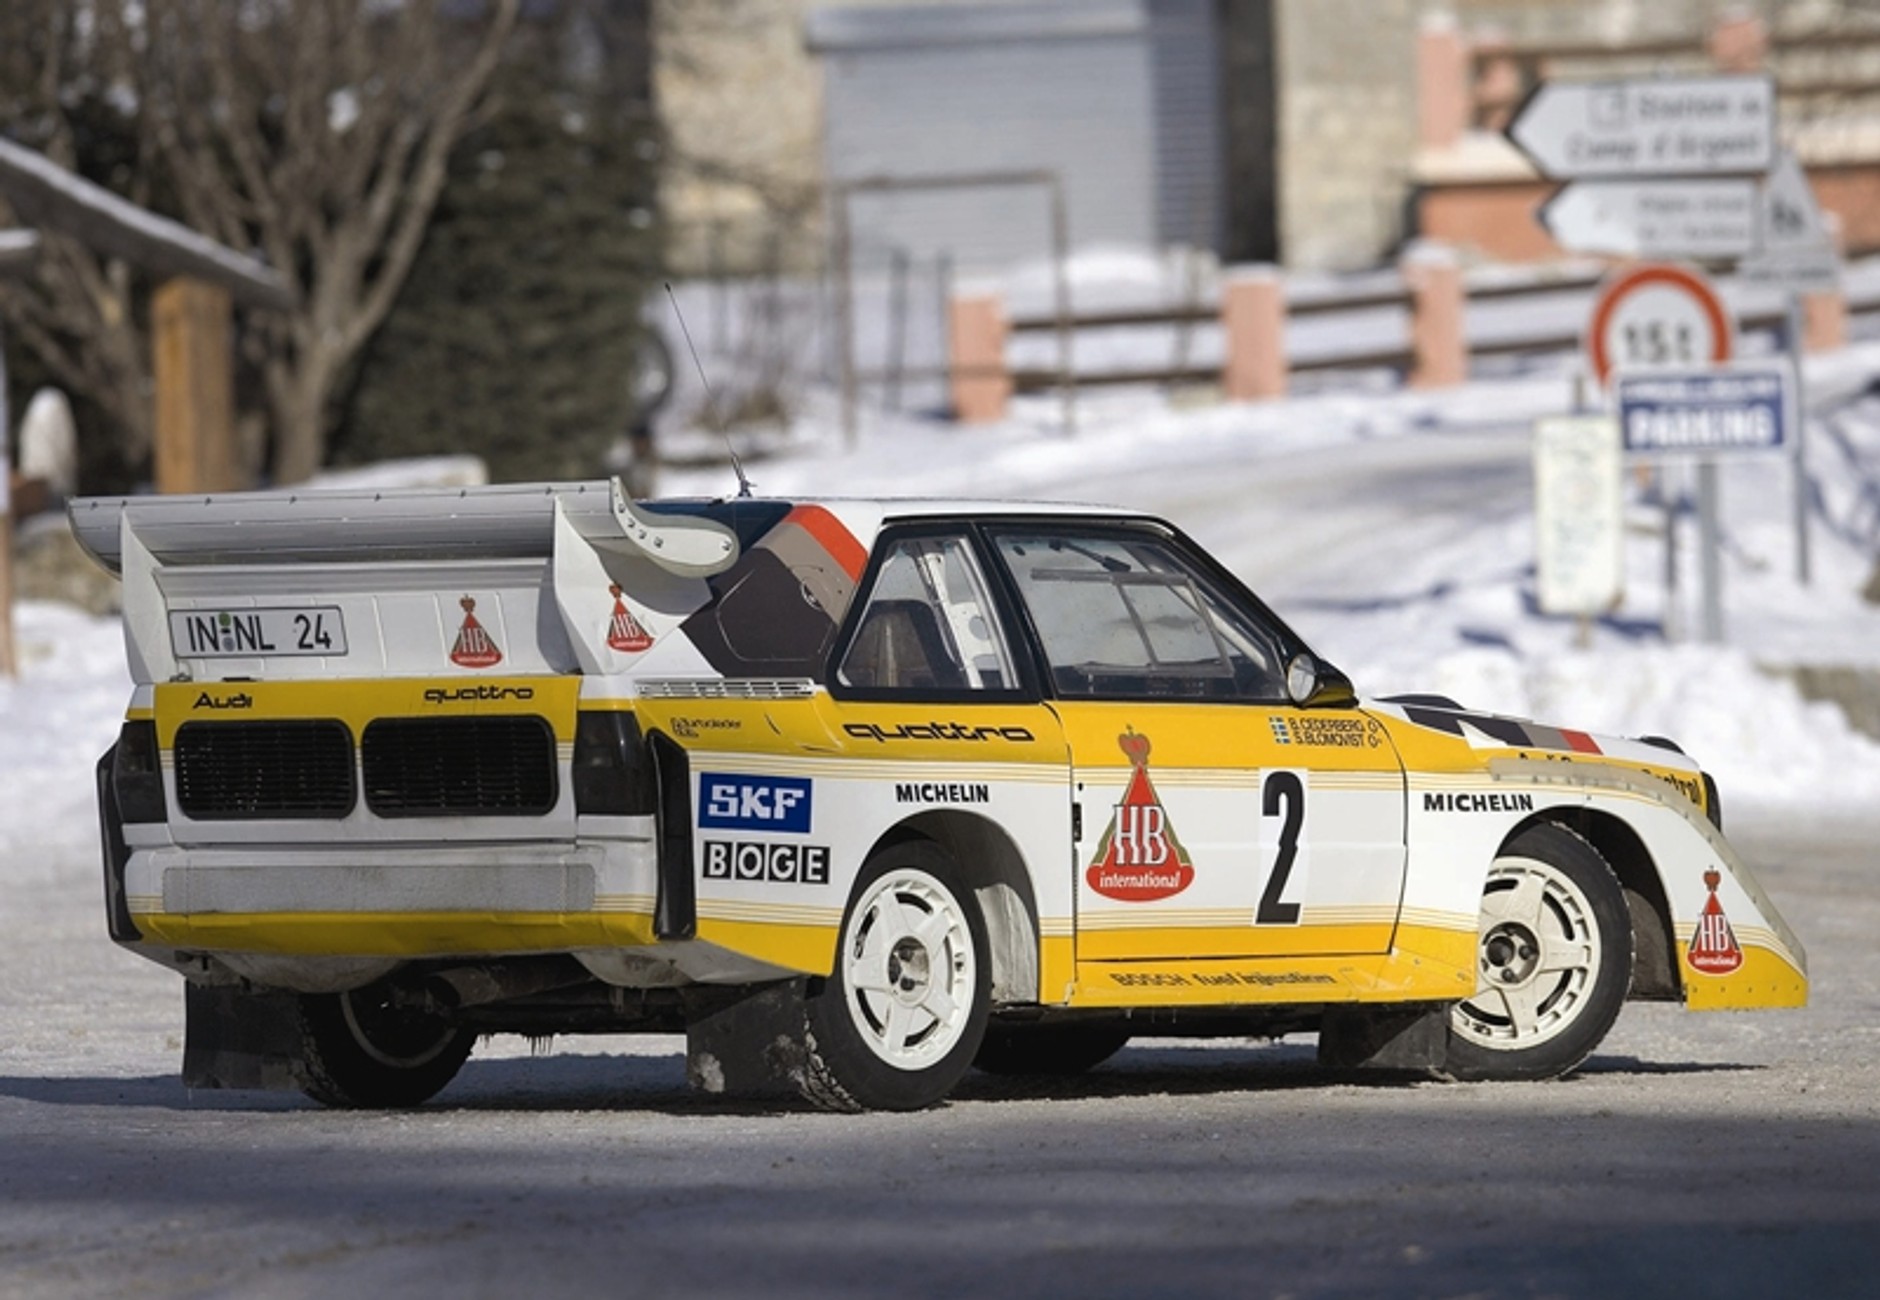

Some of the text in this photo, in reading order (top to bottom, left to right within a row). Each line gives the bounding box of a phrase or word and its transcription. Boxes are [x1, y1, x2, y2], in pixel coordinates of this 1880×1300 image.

[1629, 407, 1775, 446] PARKING
[294, 613, 331, 649] 24
[611, 613, 640, 638] HB
[459, 627, 488, 653] HB
[193, 692, 253, 709] Audi
[424, 685, 534, 704] quattro
[843, 721, 1035, 743] quattro
[707, 783, 805, 820] SKF
[896, 783, 990, 803] MICHELIN
[1424, 793, 1534, 812] MICHELIN
[1112, 803, 1169, 866] HB
[1255, 770, 1305, 925] 2
[707, 843, 825, 882] BOGE
[1099, 872, 1182, 889] international
[1699, 913, 1729, 952] HB
[1110, 973, 1192, 986] BOSCH
